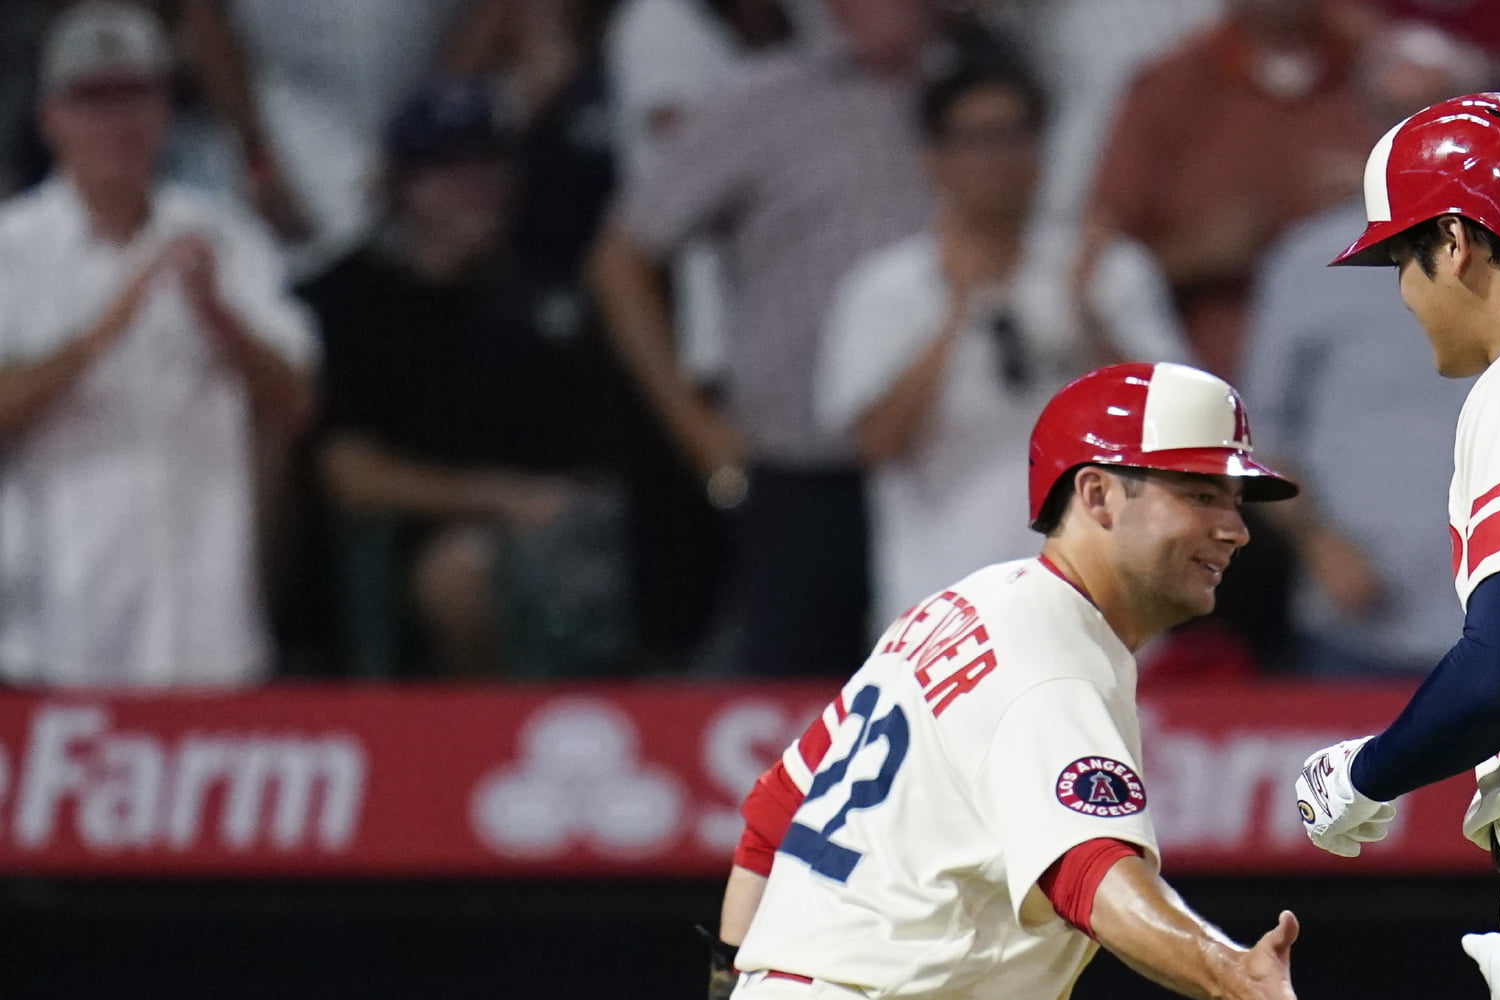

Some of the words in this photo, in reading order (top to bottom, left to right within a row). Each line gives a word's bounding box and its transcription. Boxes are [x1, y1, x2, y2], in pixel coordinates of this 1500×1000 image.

[0, 702, 366, 849] Farm
[779, 684, 910, 883] 22
[1060, 772, 1078, 797] LOS
[1077, 759, 1143, 800] ANGELES
[1070, 801, 1137, 816] ANGELS
